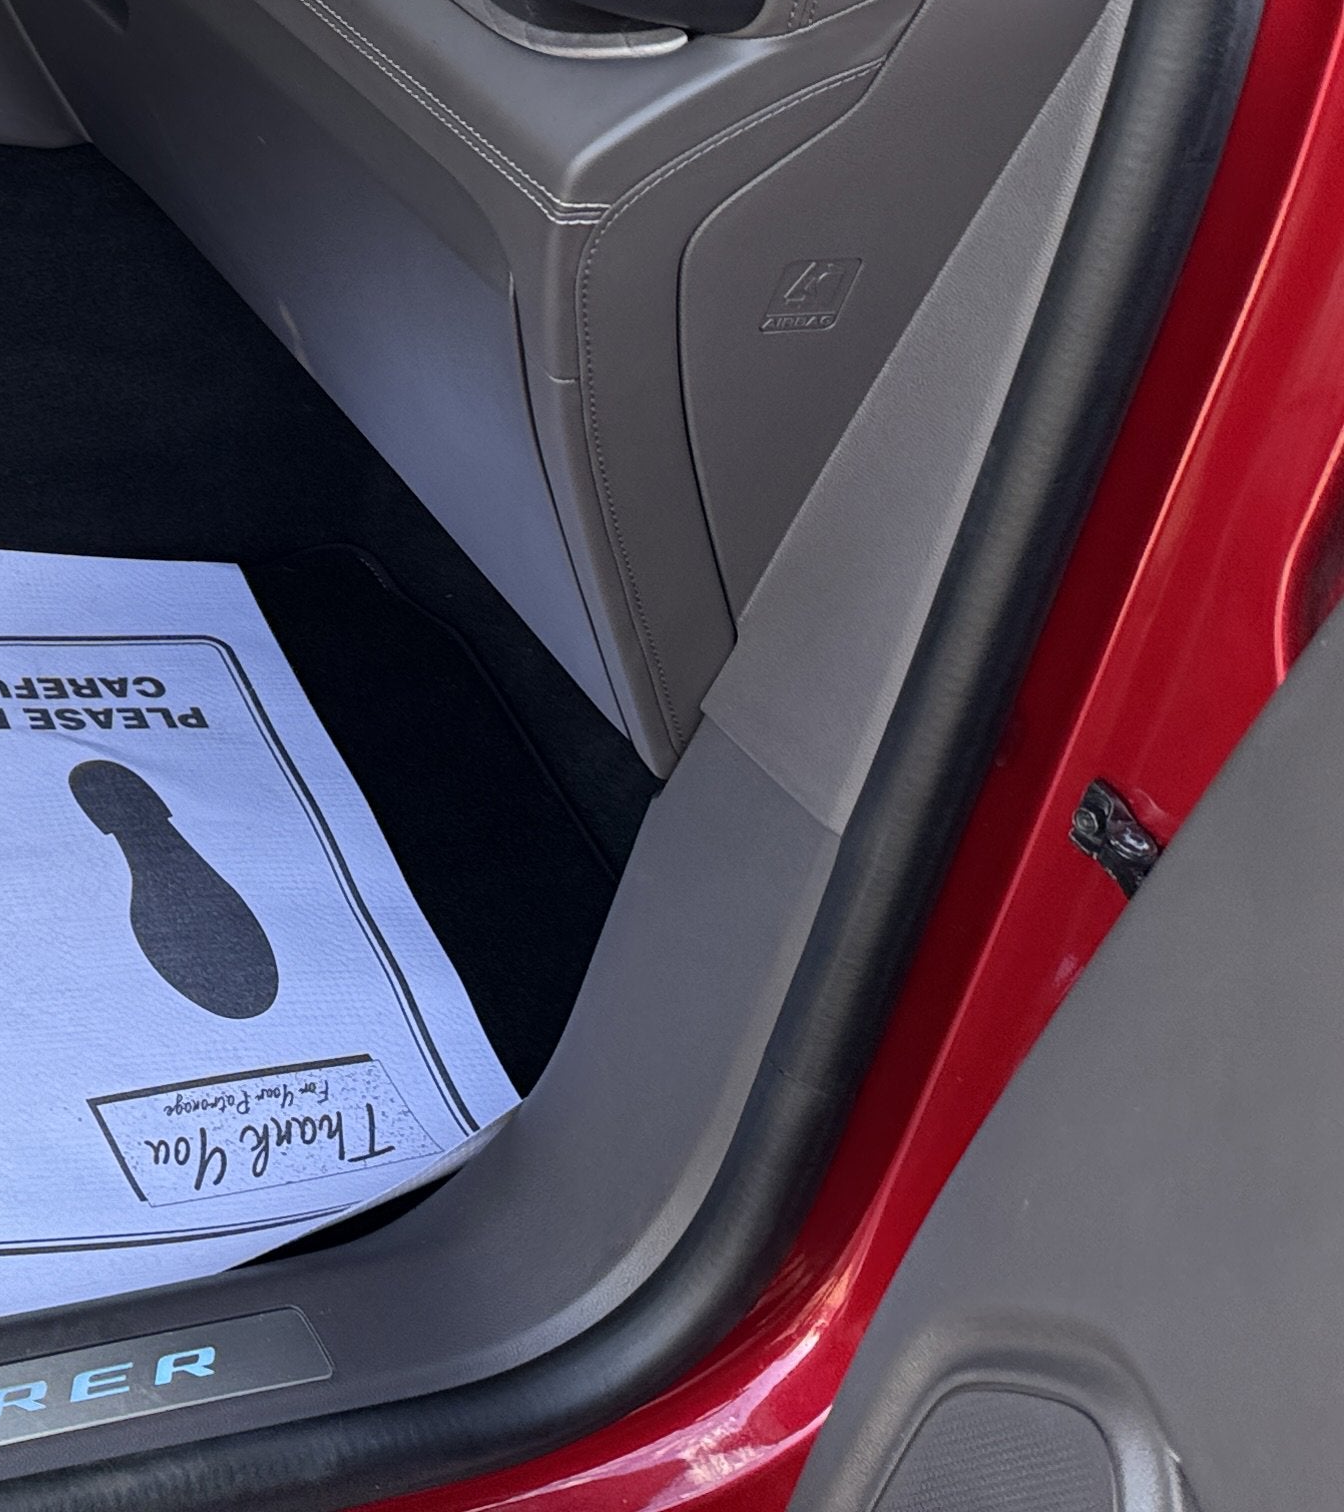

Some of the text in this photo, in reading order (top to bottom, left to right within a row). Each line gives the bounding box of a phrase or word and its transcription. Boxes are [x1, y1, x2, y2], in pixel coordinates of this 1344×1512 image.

[762, 315, 834, 330] AIRBAG
[22, 706, 210, 731] PLEASE
[163, 1079, 329, 1117] For Your Patronage
[144, 1102, 396, 1191] Thank You
